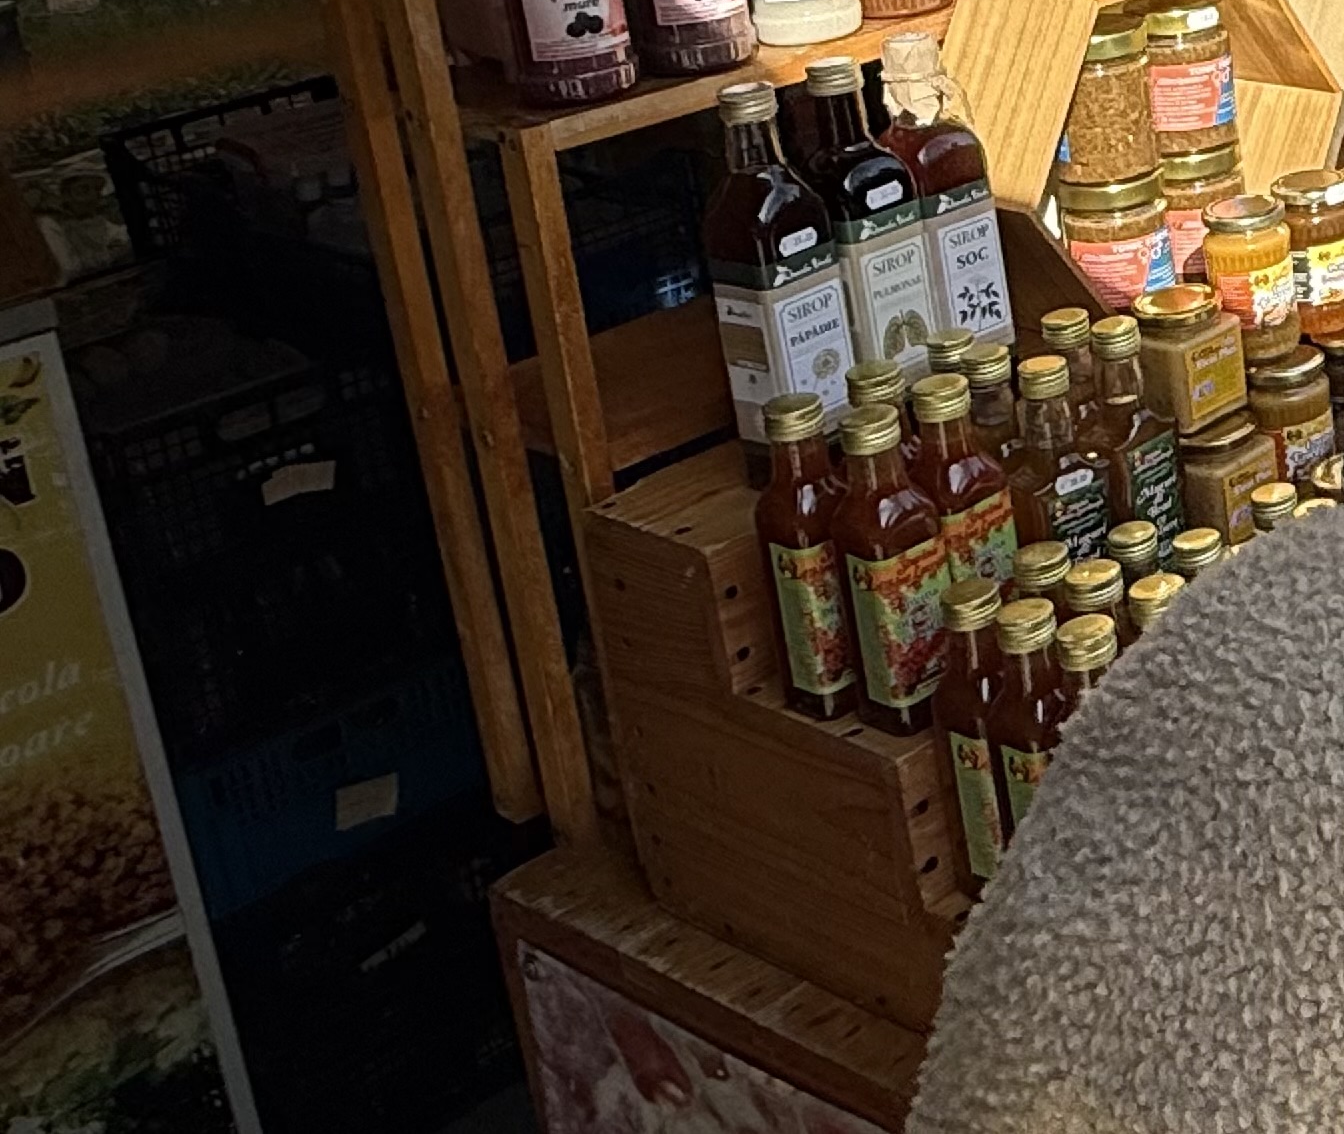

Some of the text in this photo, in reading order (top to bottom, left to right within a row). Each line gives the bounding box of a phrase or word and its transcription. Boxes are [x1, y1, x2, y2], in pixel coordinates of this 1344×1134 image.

[948, 223, 989, 249] SIROP
[873, 249, 915, 277] SIROP
[956, 246, 989, 270] SOC
[788, 293, 832, 323] SIROP
